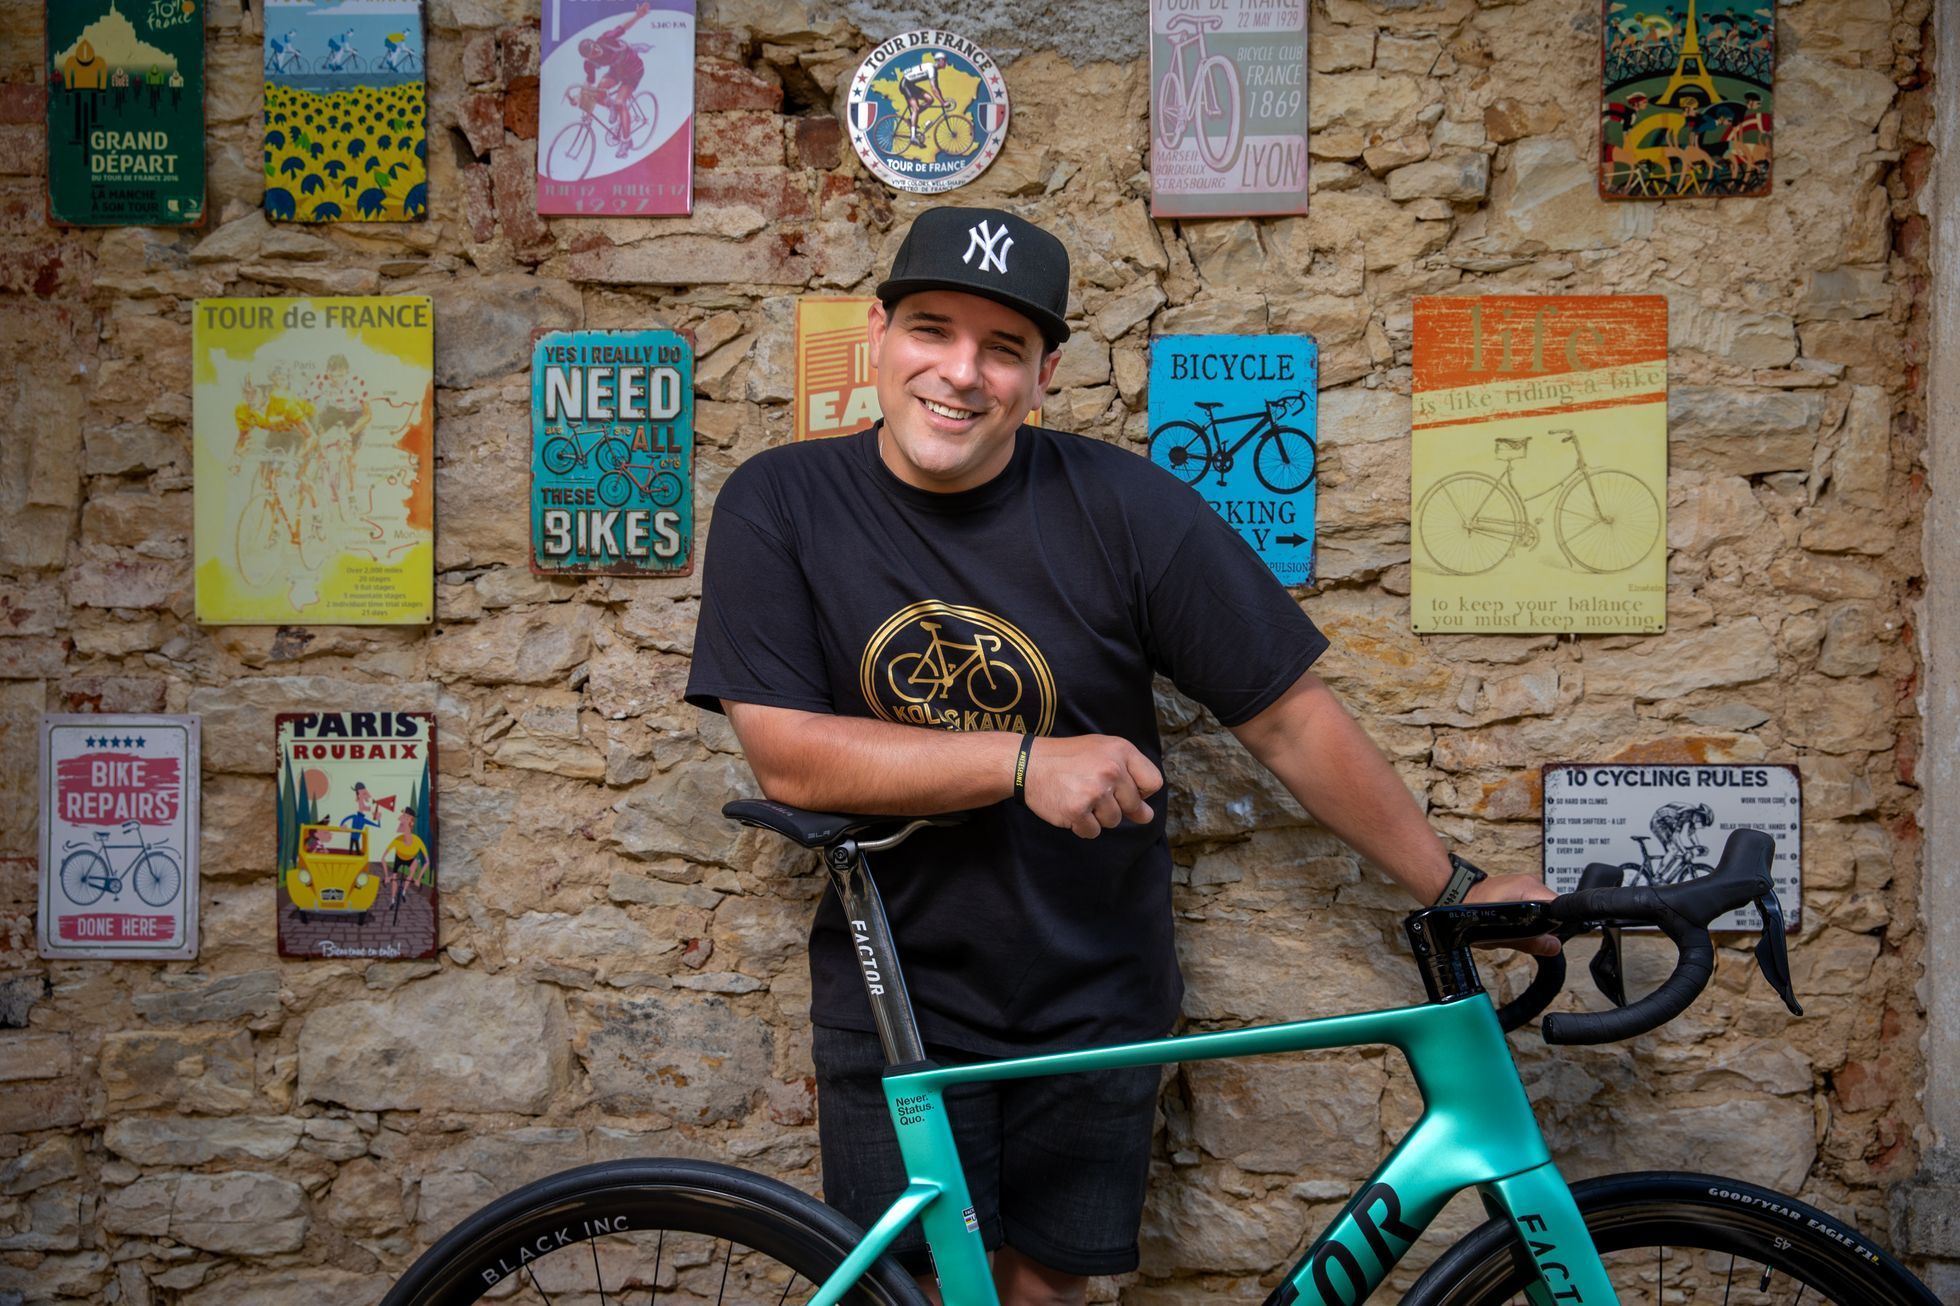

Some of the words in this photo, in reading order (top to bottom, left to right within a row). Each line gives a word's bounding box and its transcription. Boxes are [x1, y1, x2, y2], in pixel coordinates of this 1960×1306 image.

[1237, 12, 1250, 28] 22
[1253, 11, 1272, 27] MAY
[1276, 11, 1299, 27] 1929
[864, 37, 907, 71] TOUR
[908, 31, 930, 46] DE
[934, 31, 993, 72] FRANCE
[1237, 46, 1273, 61] BICYCLE
[1279, 46, 1304, 61] CLUB
[1246, 64, 1303, 86] FRANCE
[1249, 90, 1301, 118] 1869
[91, 131, 168, 150] GRAND
[91, 150, 178, 173] DÉPART
[886, 159, 913, 171] TOUR
[915, 163, 927, 172] DE
[928, 160, 966, 172] FRANCE
[1155, 164, 1206, 176] BORDEAUX
[1241, 142, 1300, 188] LYON
[1155, 177, 1226, 190] STRASBOURG
[962, 219, 1014, 275] NY
[203, 306, 275, 329] TOUR
[283, 305, 317, 329] de
[324, 304, 428, 328] FRANCE
[1466, 303, 1605, 372] life
[545, 346, 577, 363] YES
[581, 346, 587, 363] I
[591, 346, 653, 363] REALLY
[658, 346, 682, 363] DO
[1170, 353, 1295, 381] BICYCLE
[544, 365, 682, 422] NEED
[1419, 398, 1437, 414] is
[1449, 389, 1493, 411] like
[1504, 376, 1574, 404] riding
[1584, 376, 1598, 393] a
[1609, 367, 1661, 390] bike
[632, 425, 683, 453] ALL
[541, 487, 597, 505] THESE
[543, 508, 681, 559] BIKES
[1627, 583, 1664, 592] Einstein
[1432, 598, 1449, 612] to
[1459, 597, 1505, 615] keep
[1515, 599, 1558, 616] your
[1568, 597, 1644, 612] balance
[1431, 614, 1463, 631] you
[1475, 612, 1518, 627] must
[1529, 612, 1575, 631] keep
[1585, 613, 1656, 633] moving
[293, 711, 419, 737] PARIS
[293, 744, 418, 760] ROUBAIX
[91, 761, 147, 788] BIKE
[1566, 770, 1588, 787] 10
[1593, 770, 1692, 787] CYCLING
[1697, 770, 1769, 787] RULES
[66, 792, 171, 820] REPAIRS
[1556, 847, 1573, 855] EVERY
[1574, 847, 1584, 855] DAY
[1449, 911, 1477, 919] BLACK
[77, 917, 115, 936] DONE
[121, 917, 158, 937] HERE
[851, 920, 885, 996] FACTOR
[895, 1094, 929, 1107] Never.
[897, 1103, 935, 1116] Status.
[900, 1115, 925, 1126] Quo.
[1708, 1187, 1801, 1221] GOODYEAR
[1807, 1219, 1855, 1249] EAGLE
[481, 1227, 579, 1286] BLACK
[583, 1215, 630, 1238] INC
[1773, 1236, 1792, 1251] 45
